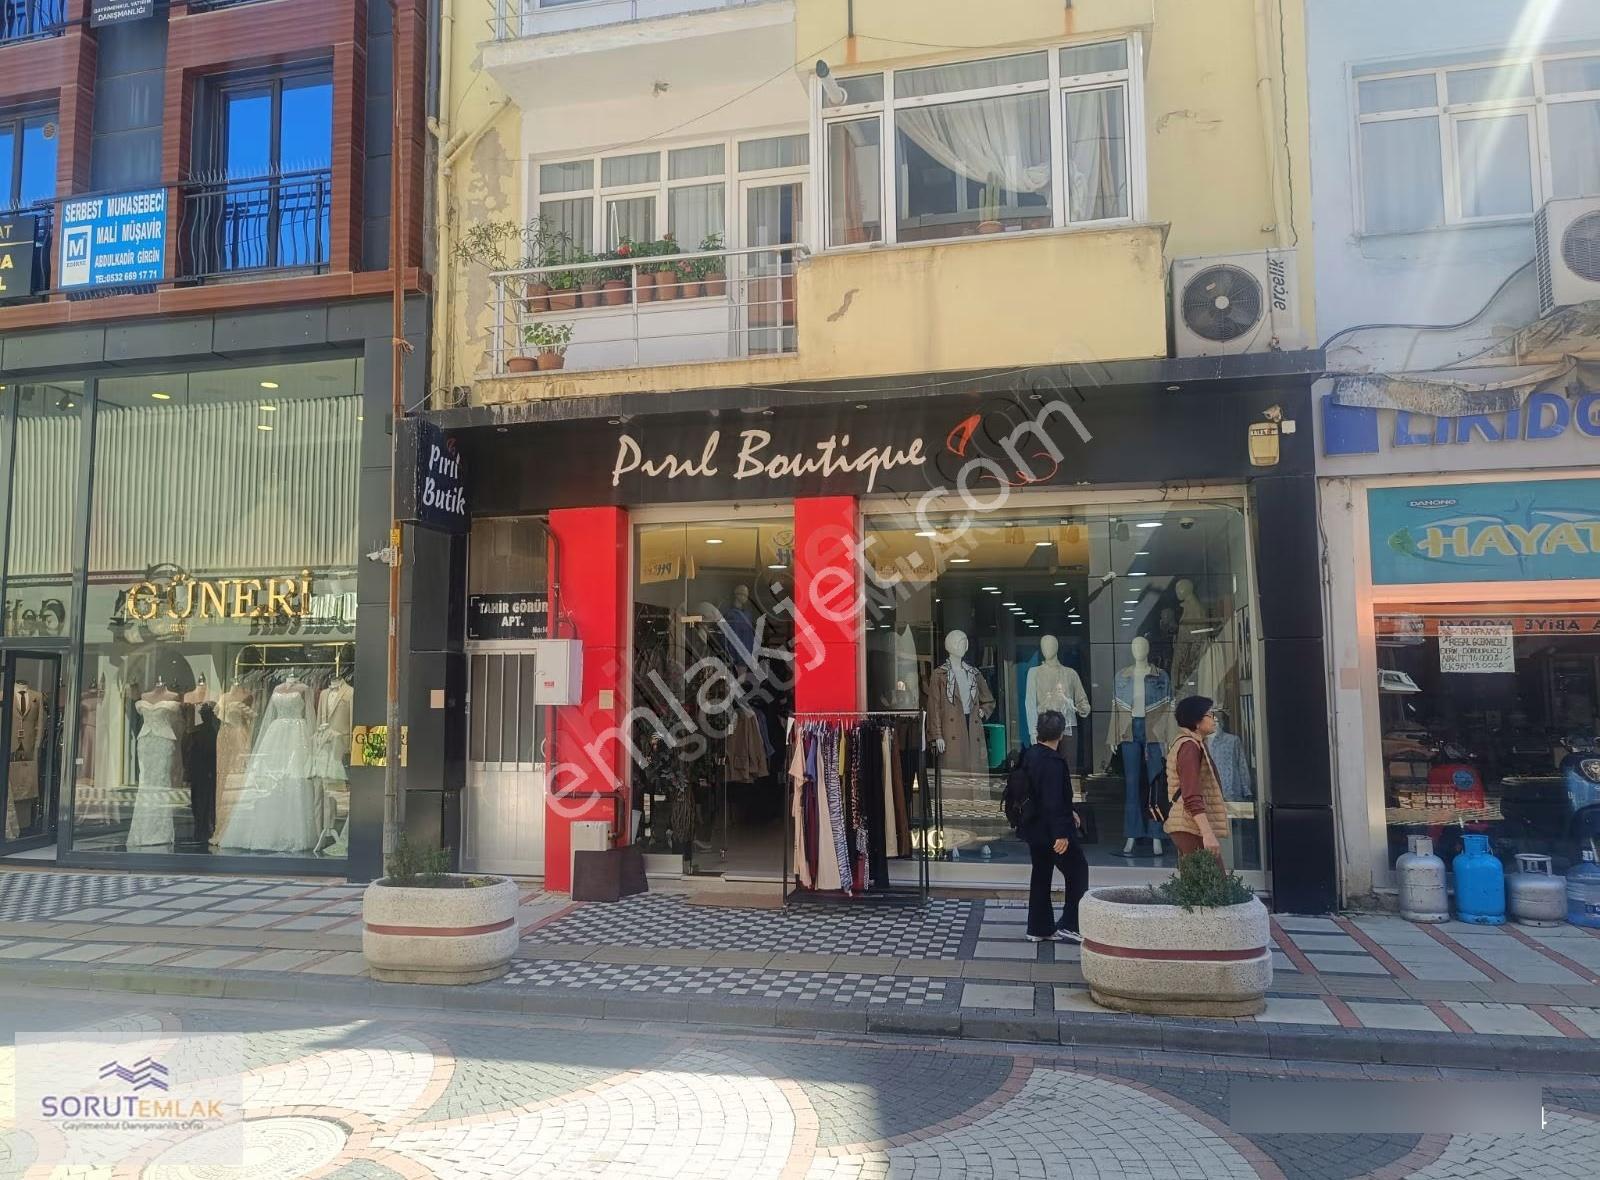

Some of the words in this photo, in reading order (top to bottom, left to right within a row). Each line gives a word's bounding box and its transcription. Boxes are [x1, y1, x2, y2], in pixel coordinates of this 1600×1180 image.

[65, 200, 103, 222] SERBEST
[107, 189, 165, 217] MUHASEBECİ
[97, 221, 118, 245] MALİ
[122, 216, 161, 245] MÜŞAVİR
[95, 250, 135, 268] ABDULKADİR
[137, 247, 160, 264] GİRGİN
[1269, 259, 1288, 311] arçelik
[612, 430, 720, 486] Pırıl
[733, 429, 927, 493] Boutique
[422, 476, 466, 516] Butik
[1417, 521, 1600, 558] HAYAT
[127, 569, 313, 620] GÜNERİ
[478, 600, 509, 614] TAHİR
[501, 616, 525, 627] APT.
